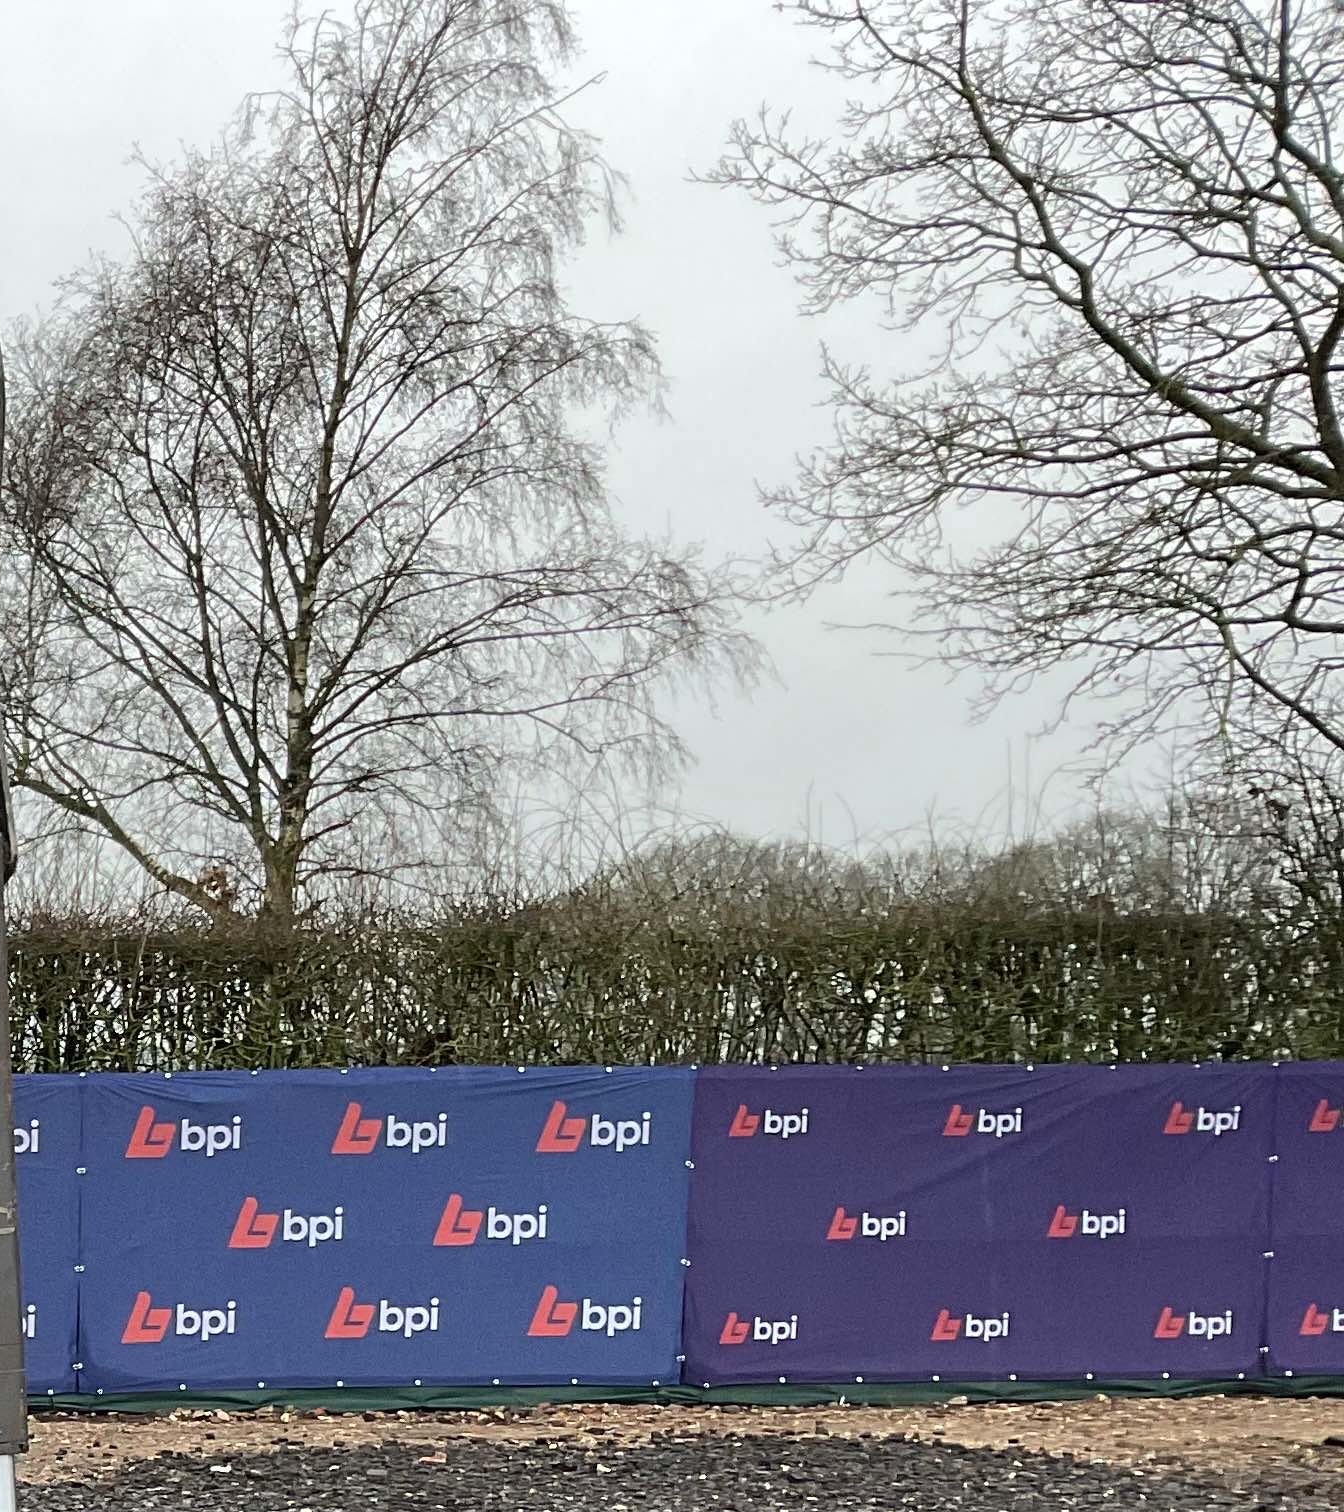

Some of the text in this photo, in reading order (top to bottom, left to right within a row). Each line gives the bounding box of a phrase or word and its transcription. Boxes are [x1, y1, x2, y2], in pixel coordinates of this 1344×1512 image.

[180, 1115, 242, 1157] bpi
[386, 1112, 448, 1154] bpi
[590, 1111, 651, 1152] bpi
[764, 1108, 809, 1139] bpi
[977, 1107, 1022, 1138] bpi
[1196, 1105, 1241, 1136] bpi
[283, 1206, 344, 1247] bpi
[487, 1204, 548, 1245] bpi
[862, 1210, 906, 1241] bpi
[1081, 1208, 1126, 1239] bpi
[175, 1300, 237, 1341] bpi
[378, 1297, 440, 1338] bpi
[581, 1296, 642, 1337] bpi
[753, 1314, 798, 1345] bpi
[965, 1311, 1010, 1342] bpi
[1188, 1310, 1233, 1340] bpi
